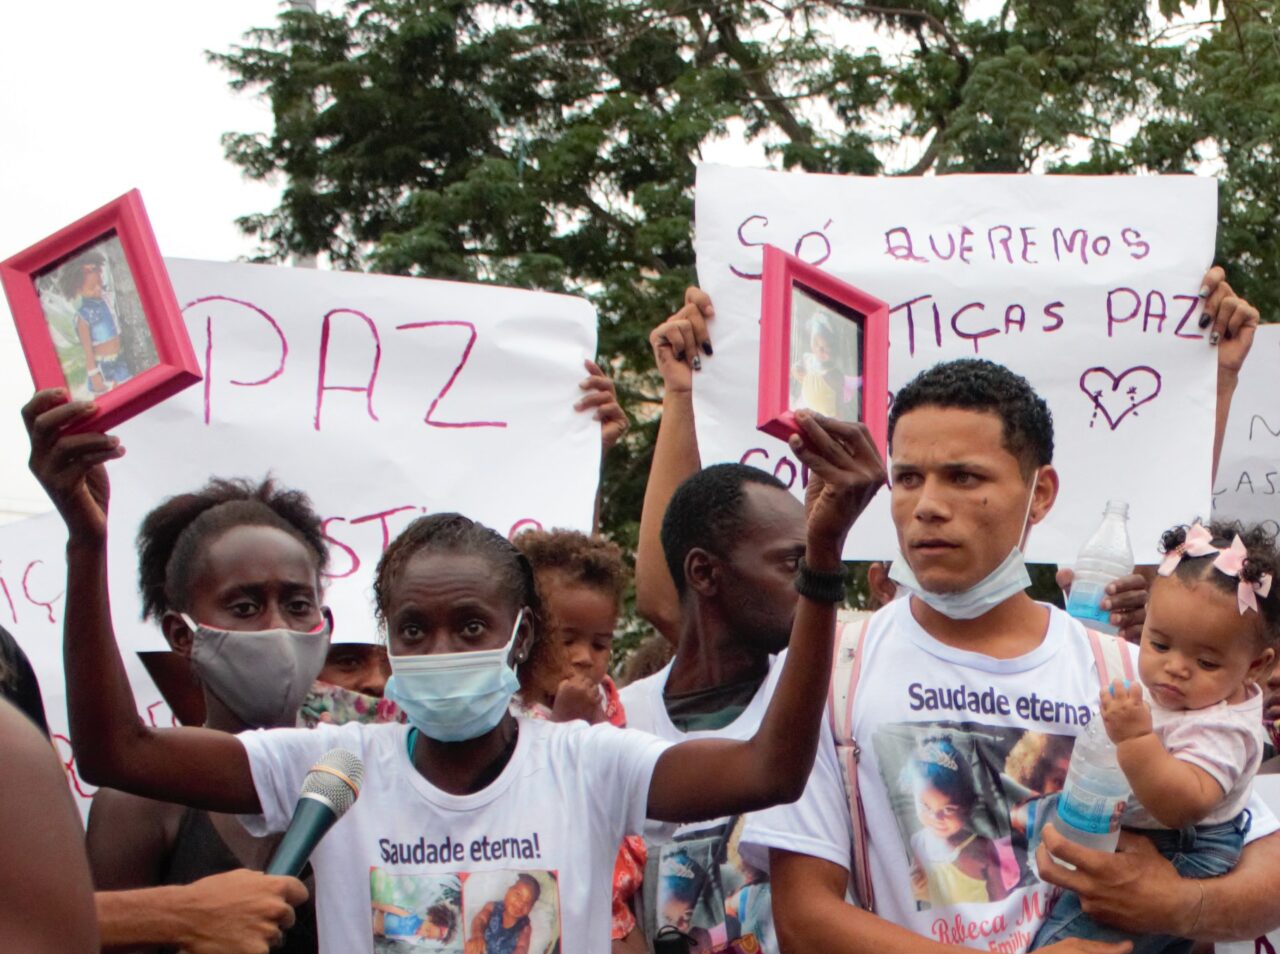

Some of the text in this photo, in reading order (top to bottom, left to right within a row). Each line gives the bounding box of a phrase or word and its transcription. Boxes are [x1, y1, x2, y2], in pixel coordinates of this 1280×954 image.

[884, 224, 1151, 265] QUEREMOS
[888, 287, 1204, 355] TIÇAS PAZ
[180, 294, 507, 431] PAZ
[908, 682, 1010, 716] Saudade
[379, 832, 542, 865] Saudade eterna!
[931, 913, 1007, 945] Rebeca
